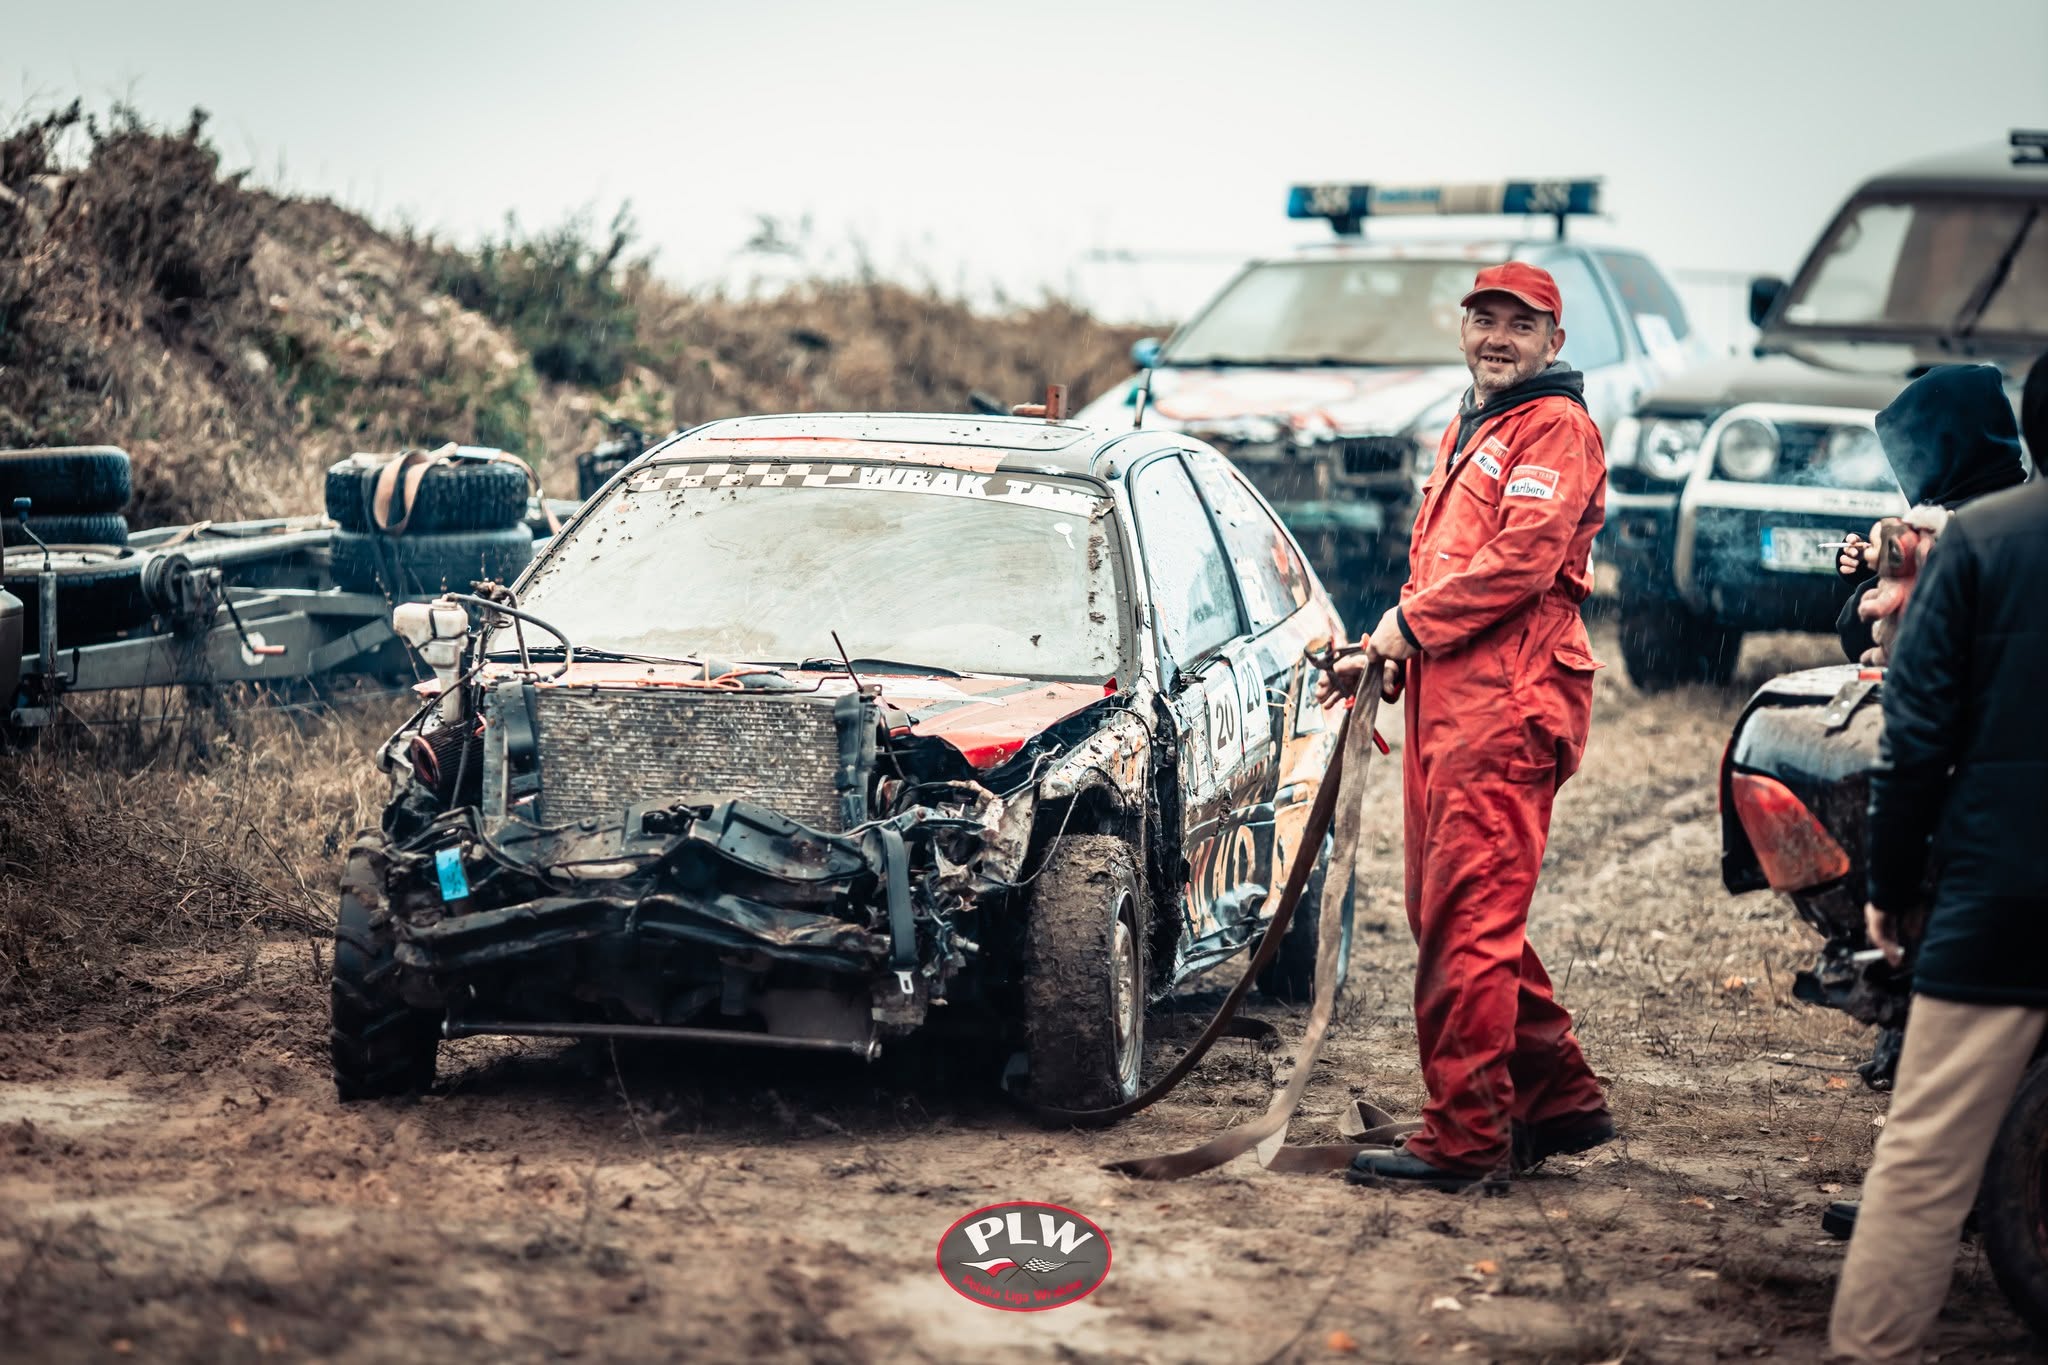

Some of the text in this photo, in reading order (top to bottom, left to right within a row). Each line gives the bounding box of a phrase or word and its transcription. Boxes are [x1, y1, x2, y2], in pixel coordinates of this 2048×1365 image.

[859, 466, 992, 498] WRAK
[1511, 482, 1546, 497] Marlboro
[1216, 693, 1235, 751] 20
